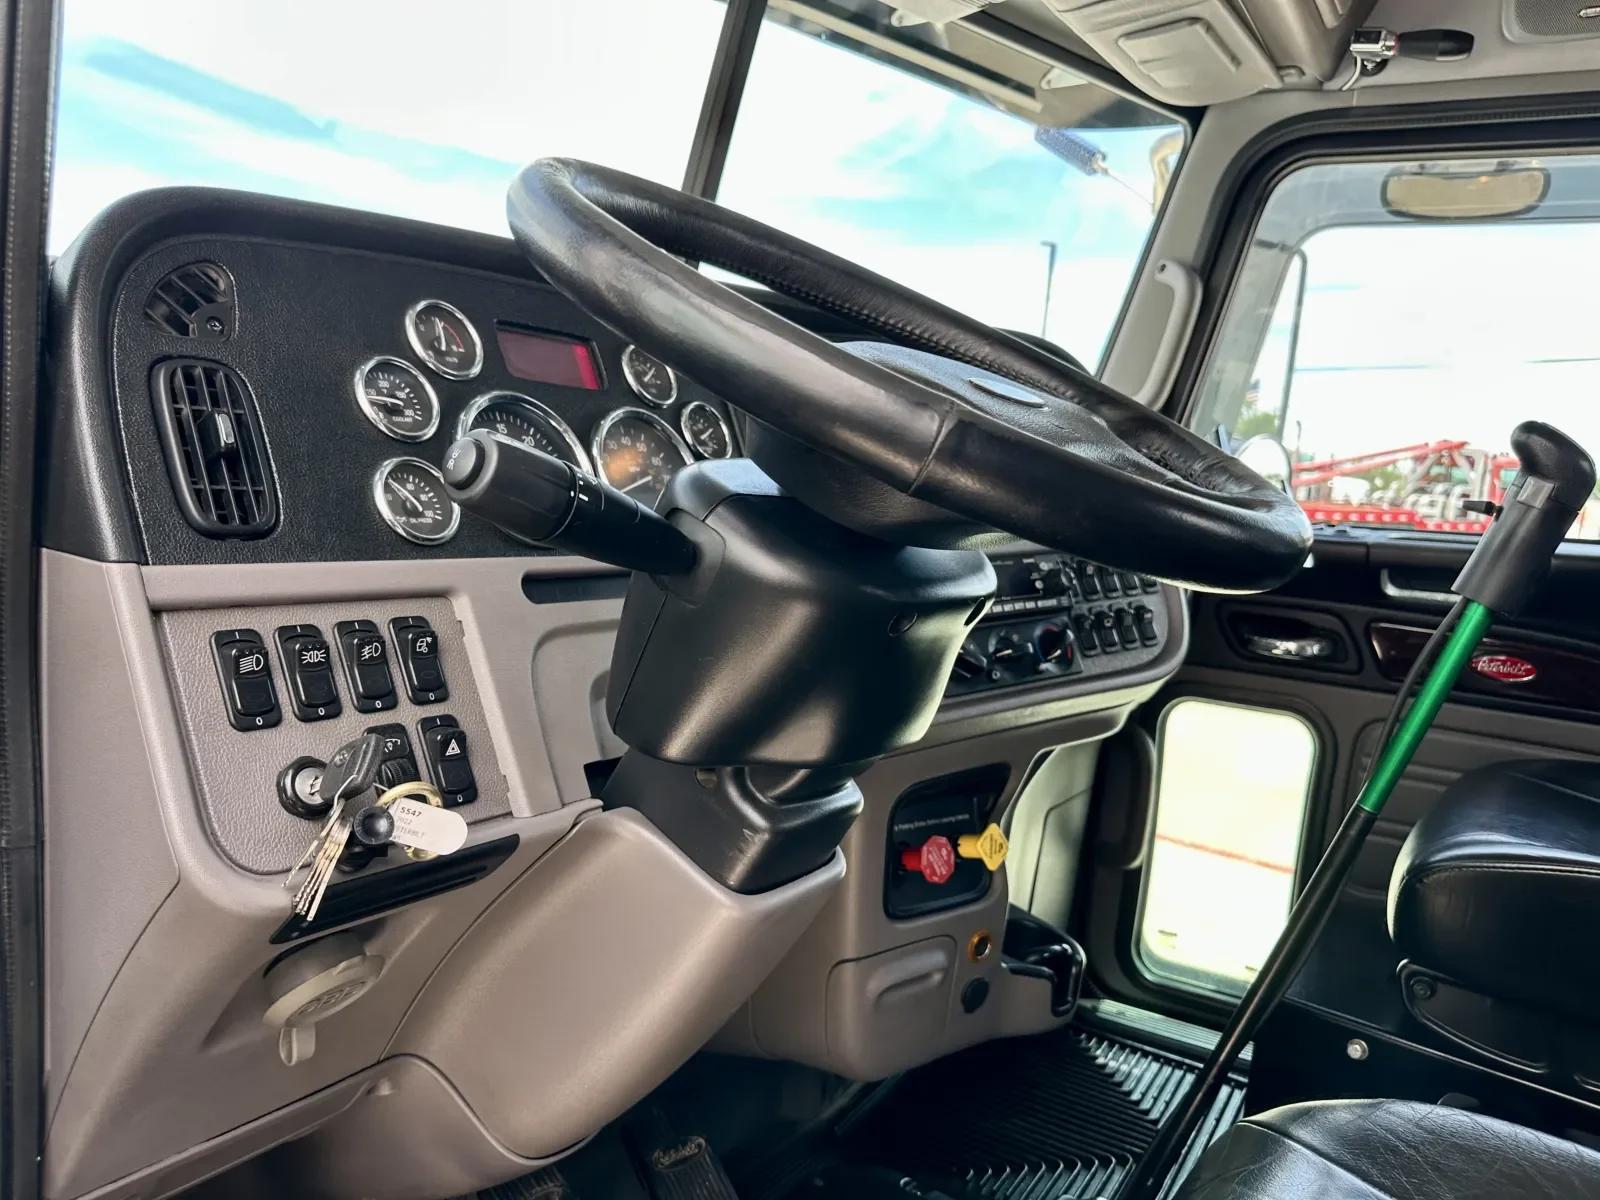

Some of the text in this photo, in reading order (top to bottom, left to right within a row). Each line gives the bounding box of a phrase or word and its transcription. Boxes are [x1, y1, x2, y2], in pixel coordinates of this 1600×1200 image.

[496, 424, 508, 434] 15
[521, 436, 535, 447] 20
[621, 436, 632, 447] 40
[1477, 656, 1531, 676] Peterbilt
[400, 806, 423, 818] 5547
